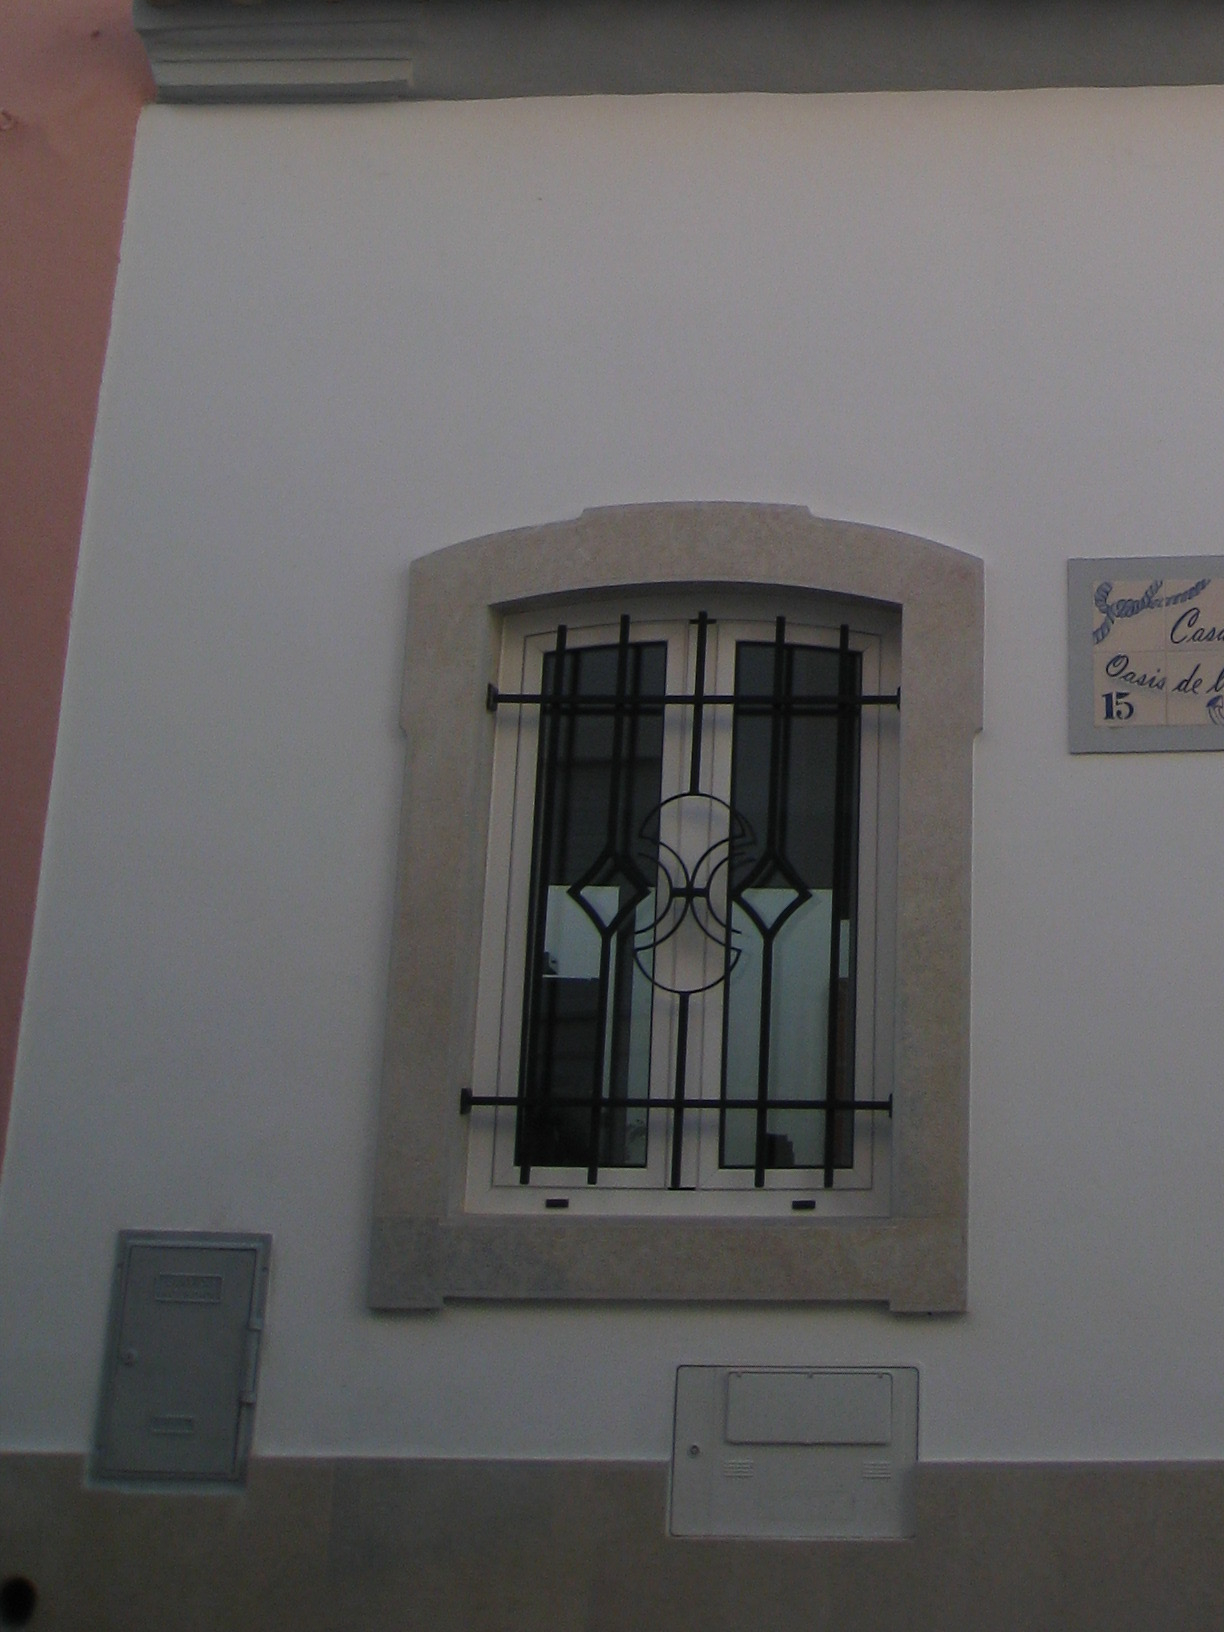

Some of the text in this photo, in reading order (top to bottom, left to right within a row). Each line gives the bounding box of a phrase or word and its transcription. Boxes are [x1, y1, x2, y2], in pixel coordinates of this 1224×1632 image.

[1105, 653, 1167, 691] Oasis
[1172, 663, 1203, 694] de
[1101, 692, 1134, 720] 15
